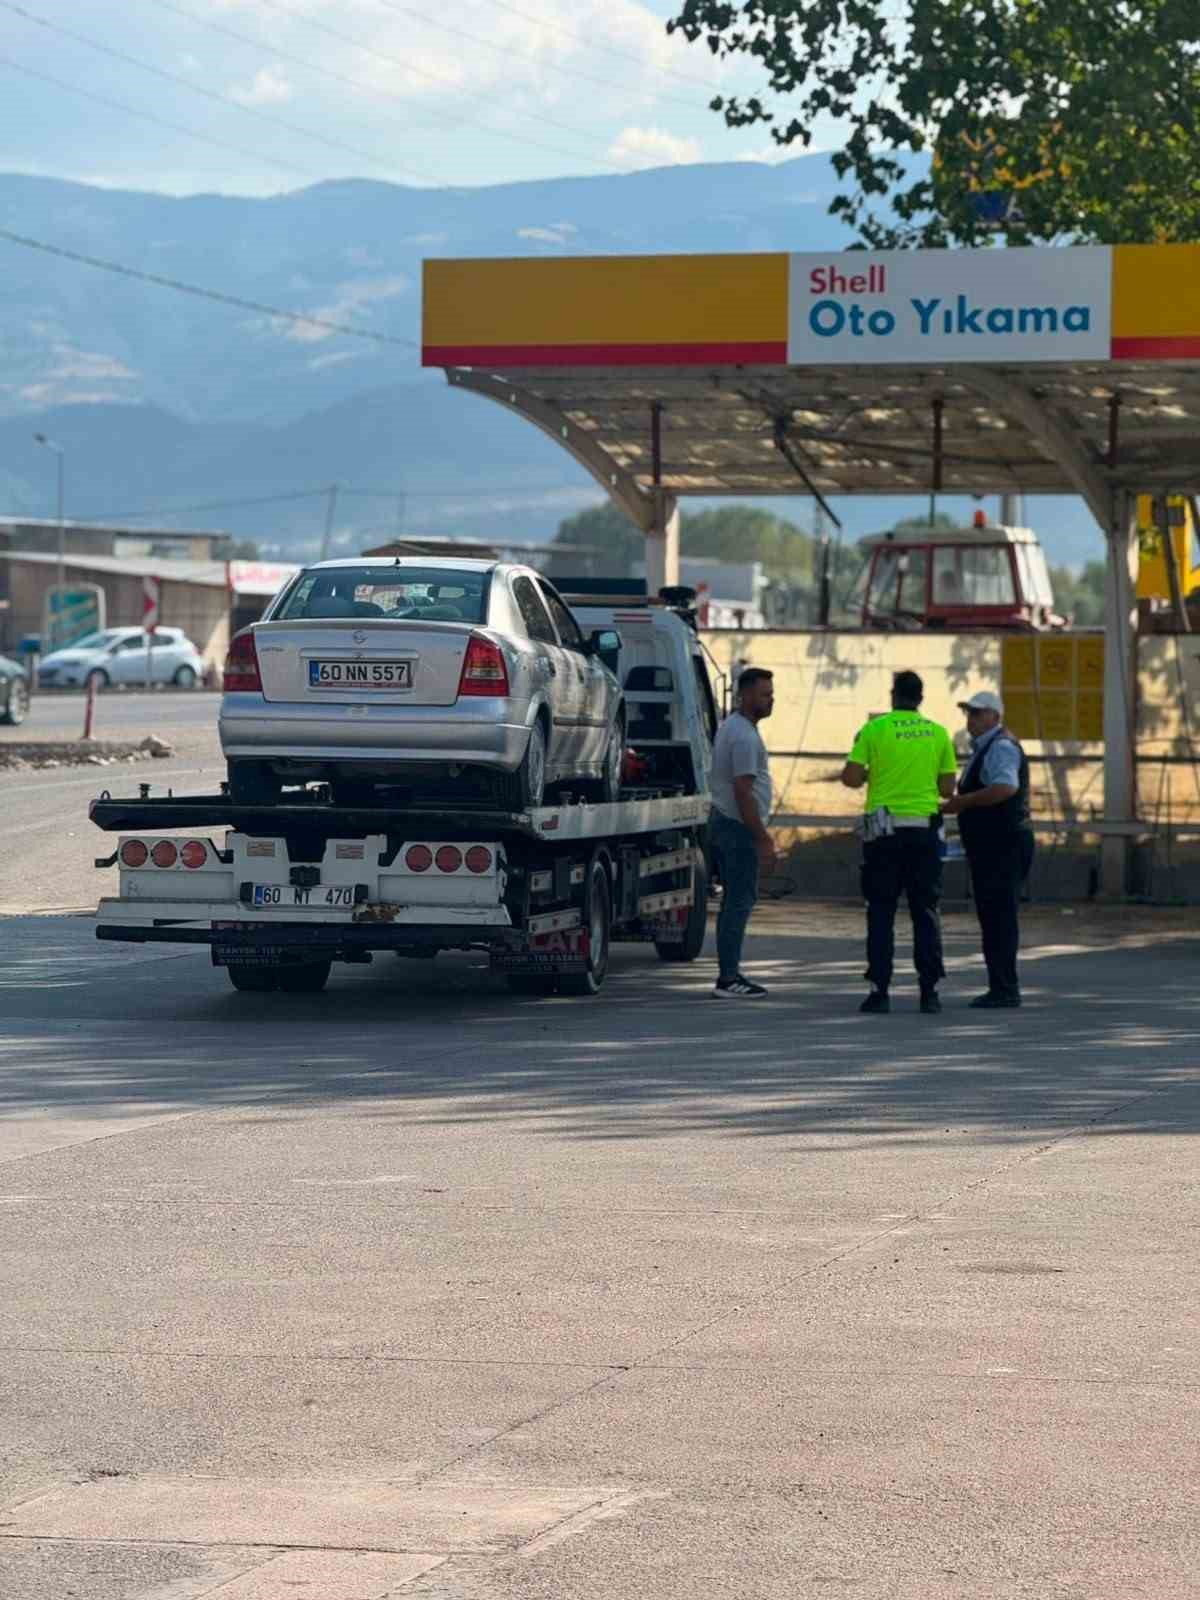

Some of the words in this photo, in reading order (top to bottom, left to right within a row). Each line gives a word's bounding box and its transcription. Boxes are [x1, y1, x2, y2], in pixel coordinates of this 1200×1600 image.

[809, 265, 885, 294] Shell
[809, 299, 895, 337] Oto
[910, 294, 1090, 335] Yıkama
[319, 665, 342, 682] 60
[346, 665, 368, 682] NN
[372, 665, 405, 682] 557
[263, 887, 281, 904] 60
[294, 887, 312, 905] NT
[325, 887, 353, 905] 470
